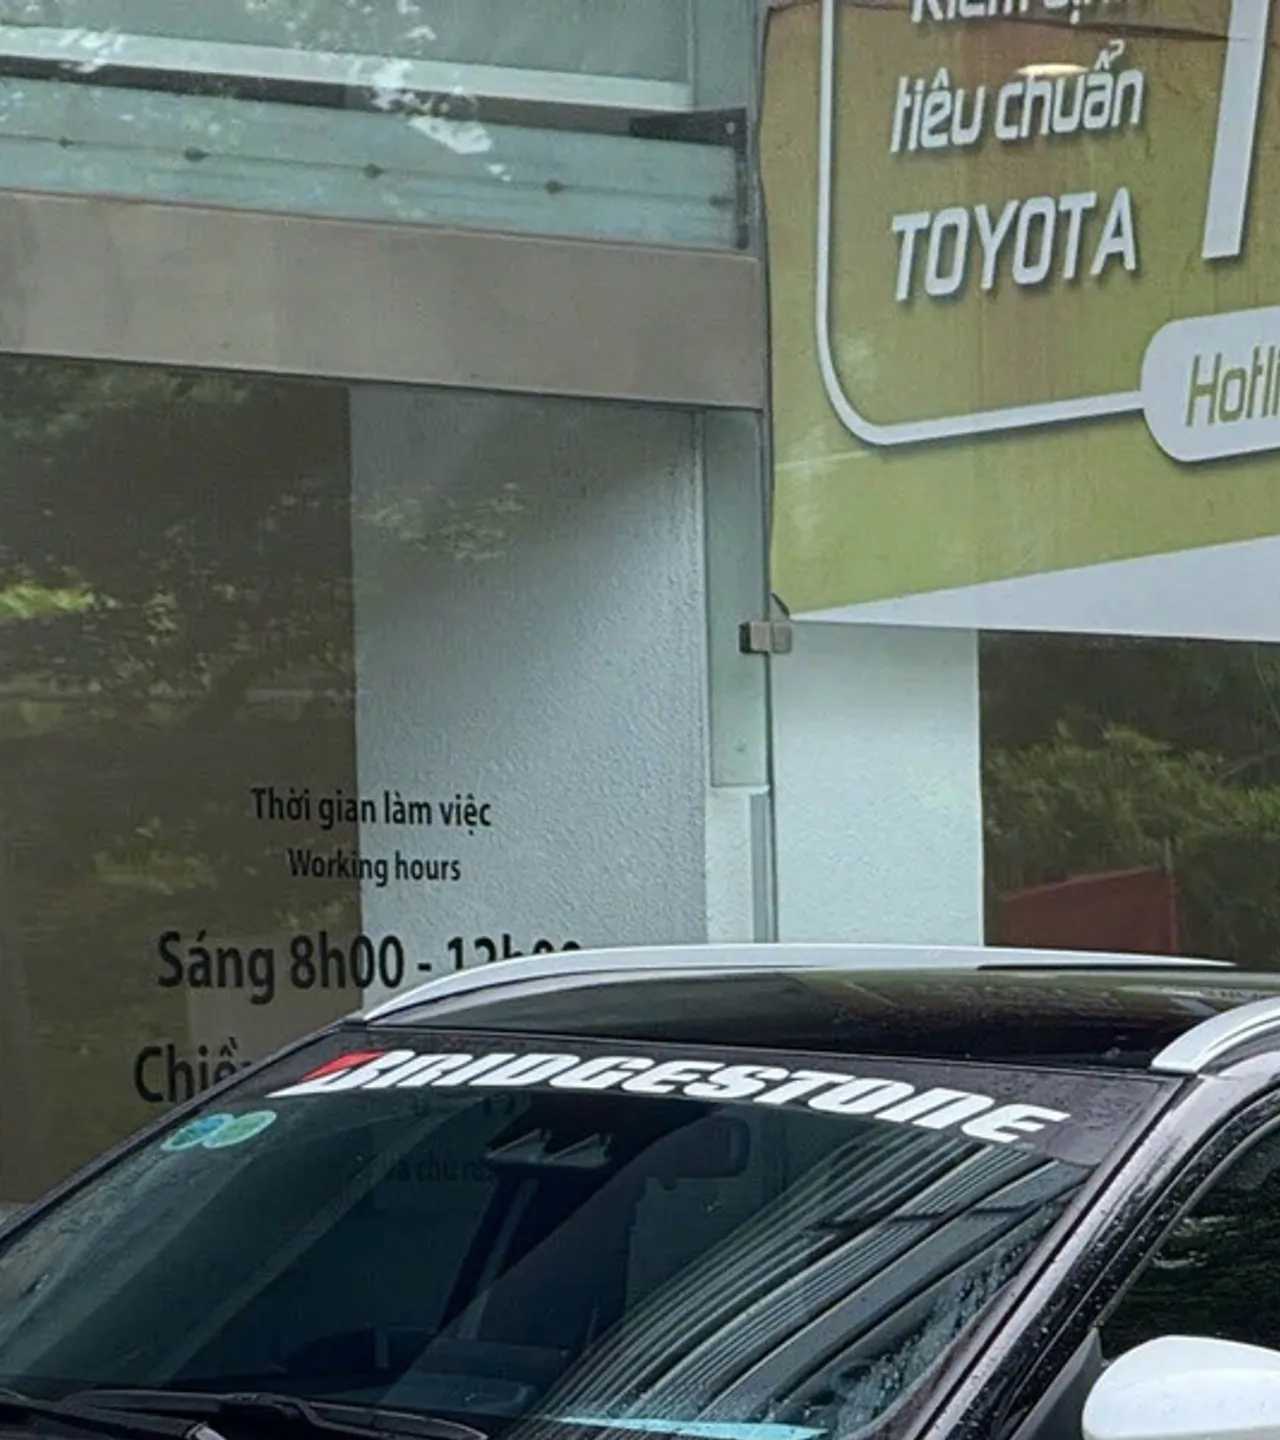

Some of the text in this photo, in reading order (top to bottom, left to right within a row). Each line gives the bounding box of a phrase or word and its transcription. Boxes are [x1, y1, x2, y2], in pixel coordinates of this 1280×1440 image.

[890, 39, 1145, 154] tiêu chuẩn
[891, 187, 1138, 301] TOYOTA
[251, 788, 491, 836] Thời gian làm việc
[288, 849, 461, 887] Working hours
[158, 929, 275, 1005] Sáng
[290, 931, 404, 989] 8h00
[134, 1037, 253, 1101] Chiề
[266, 1048, 1072, 1145] BRIDGESTONE
